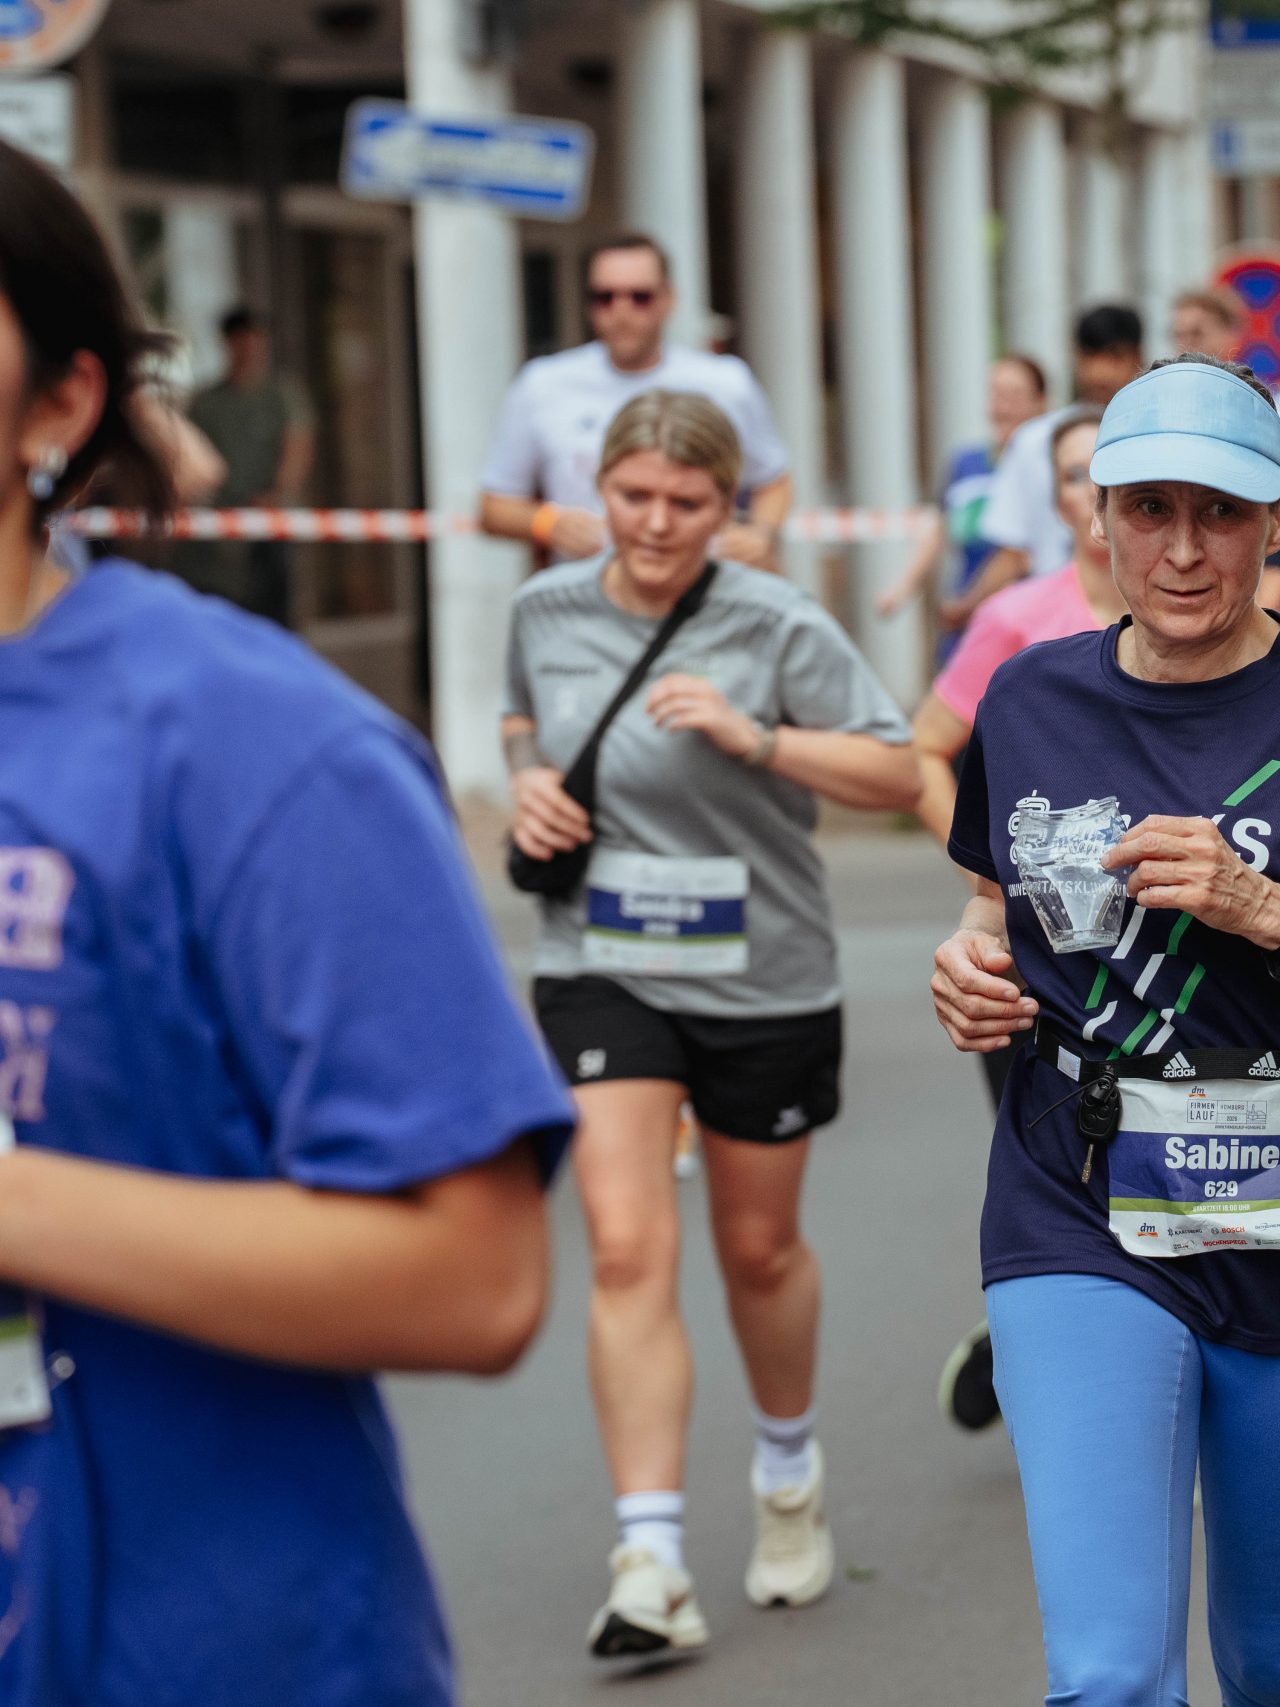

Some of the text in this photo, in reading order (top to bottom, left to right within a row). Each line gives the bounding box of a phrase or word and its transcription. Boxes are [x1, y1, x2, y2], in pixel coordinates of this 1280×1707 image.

[1162, 1067, 1196, 1078] adidas
[1248, 1067, 1280, 1078] adidas
[1191, 1085, 1205, 1095] dm
[1190, 1102, 1215, 1110] FIRMEN
[1190, 1110, 1215, 1121] LAUF
[1165, 1137, 1280, 1170] Sabine
[1204, 1180, 1239, 1198] 629
[1140, 1222, 1156, 1233] dm
[1202, 1239, 1249, 1247] WOCHENSPIEGEL
